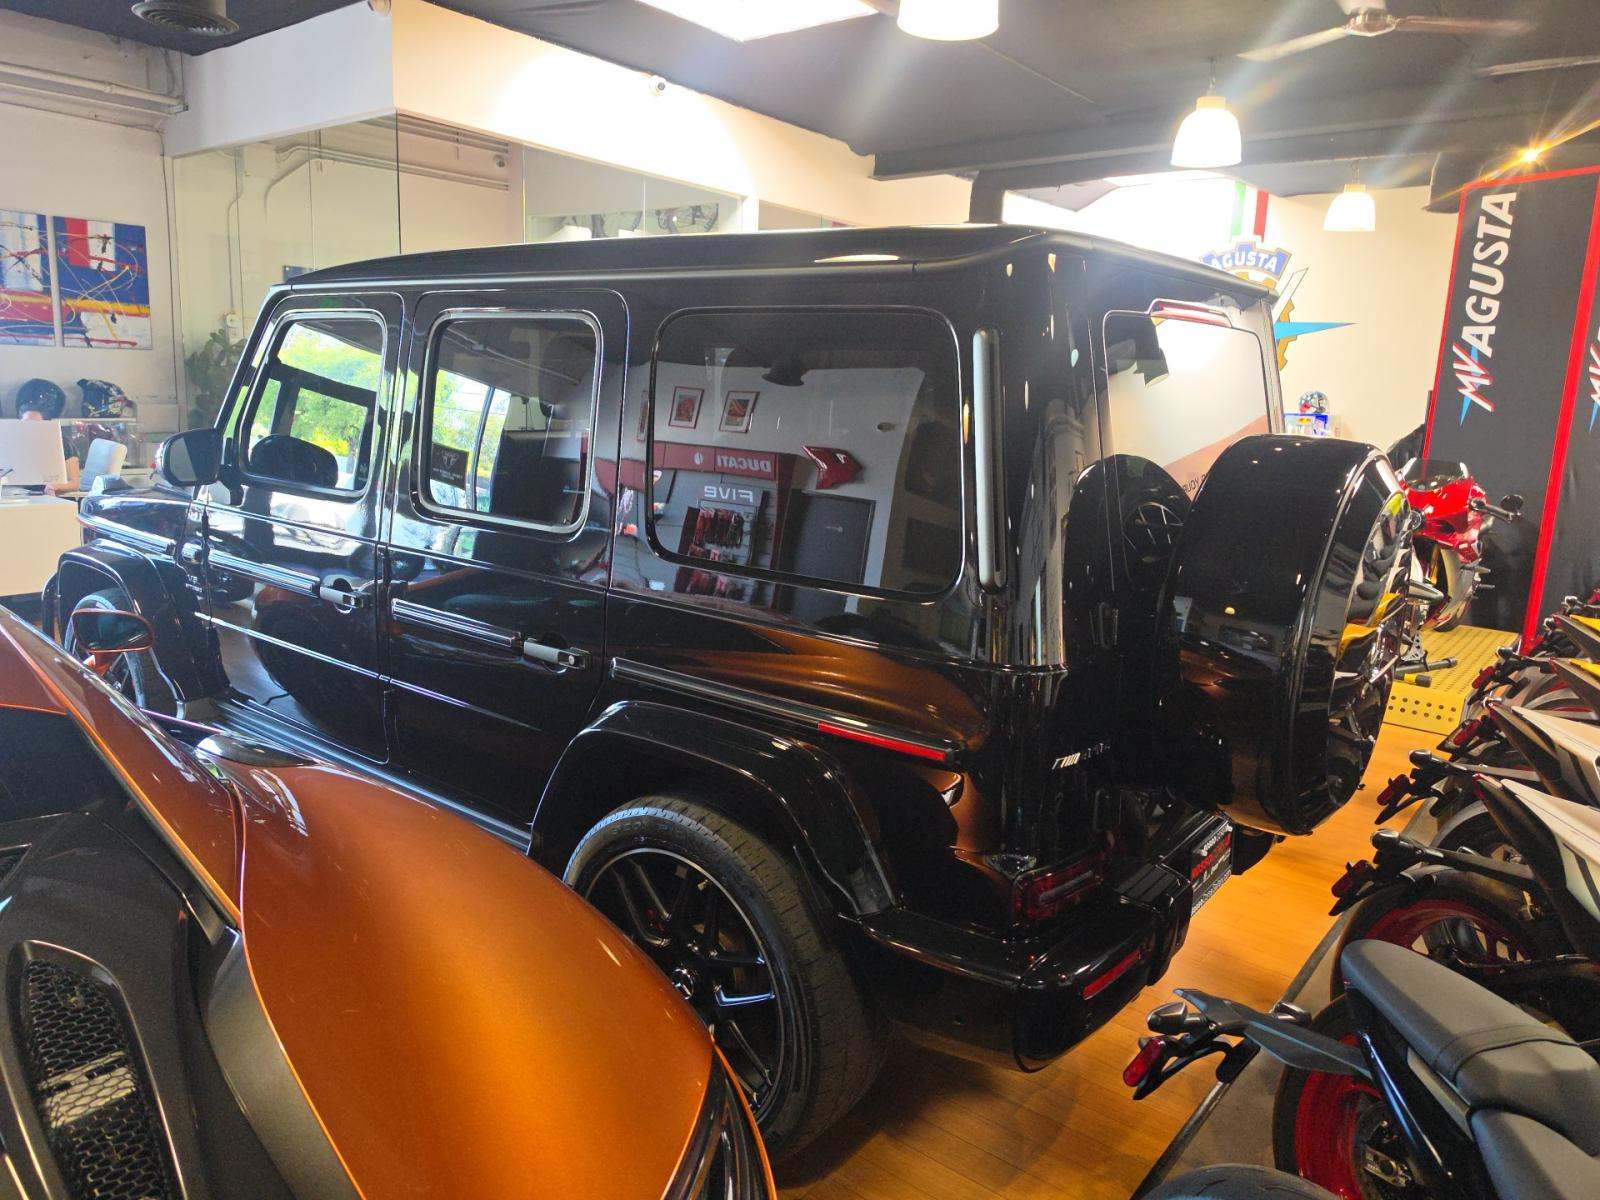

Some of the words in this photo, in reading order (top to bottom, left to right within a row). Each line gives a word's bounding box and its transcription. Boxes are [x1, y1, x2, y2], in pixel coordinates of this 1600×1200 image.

[1211, 250, 1278, 272] AGUSTA
[1461, 192, 1517, 358] AGUSTA
[1453, 345, 1495, 412] MV
